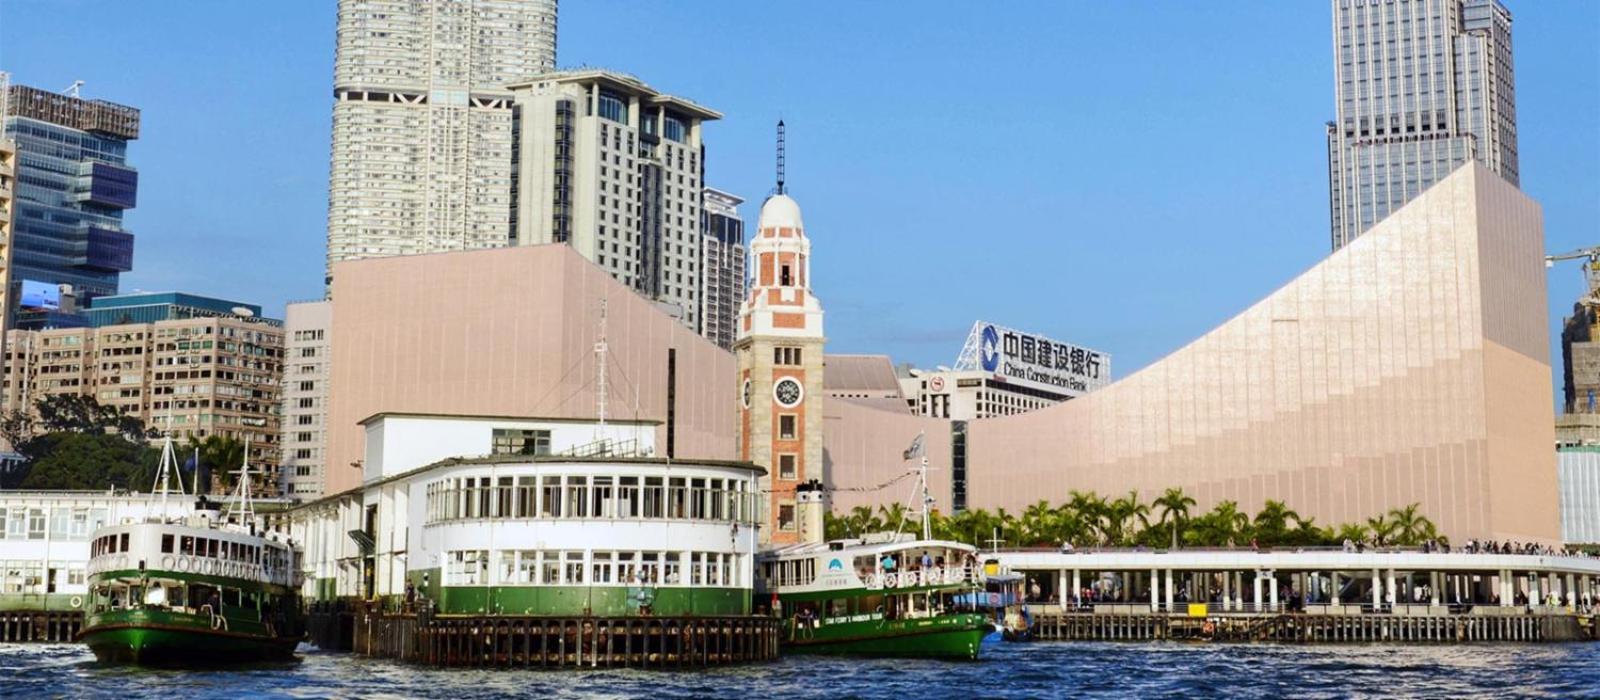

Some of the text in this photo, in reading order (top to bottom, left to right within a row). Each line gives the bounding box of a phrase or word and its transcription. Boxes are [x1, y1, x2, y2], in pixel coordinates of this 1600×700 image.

[1004, 332, 1100, 378] 中国建设银行
[1004, 362, 1025, 379] China
[1027, 366, 1069, 389] Construction
[1070, 377, 1088, 391] Bank
